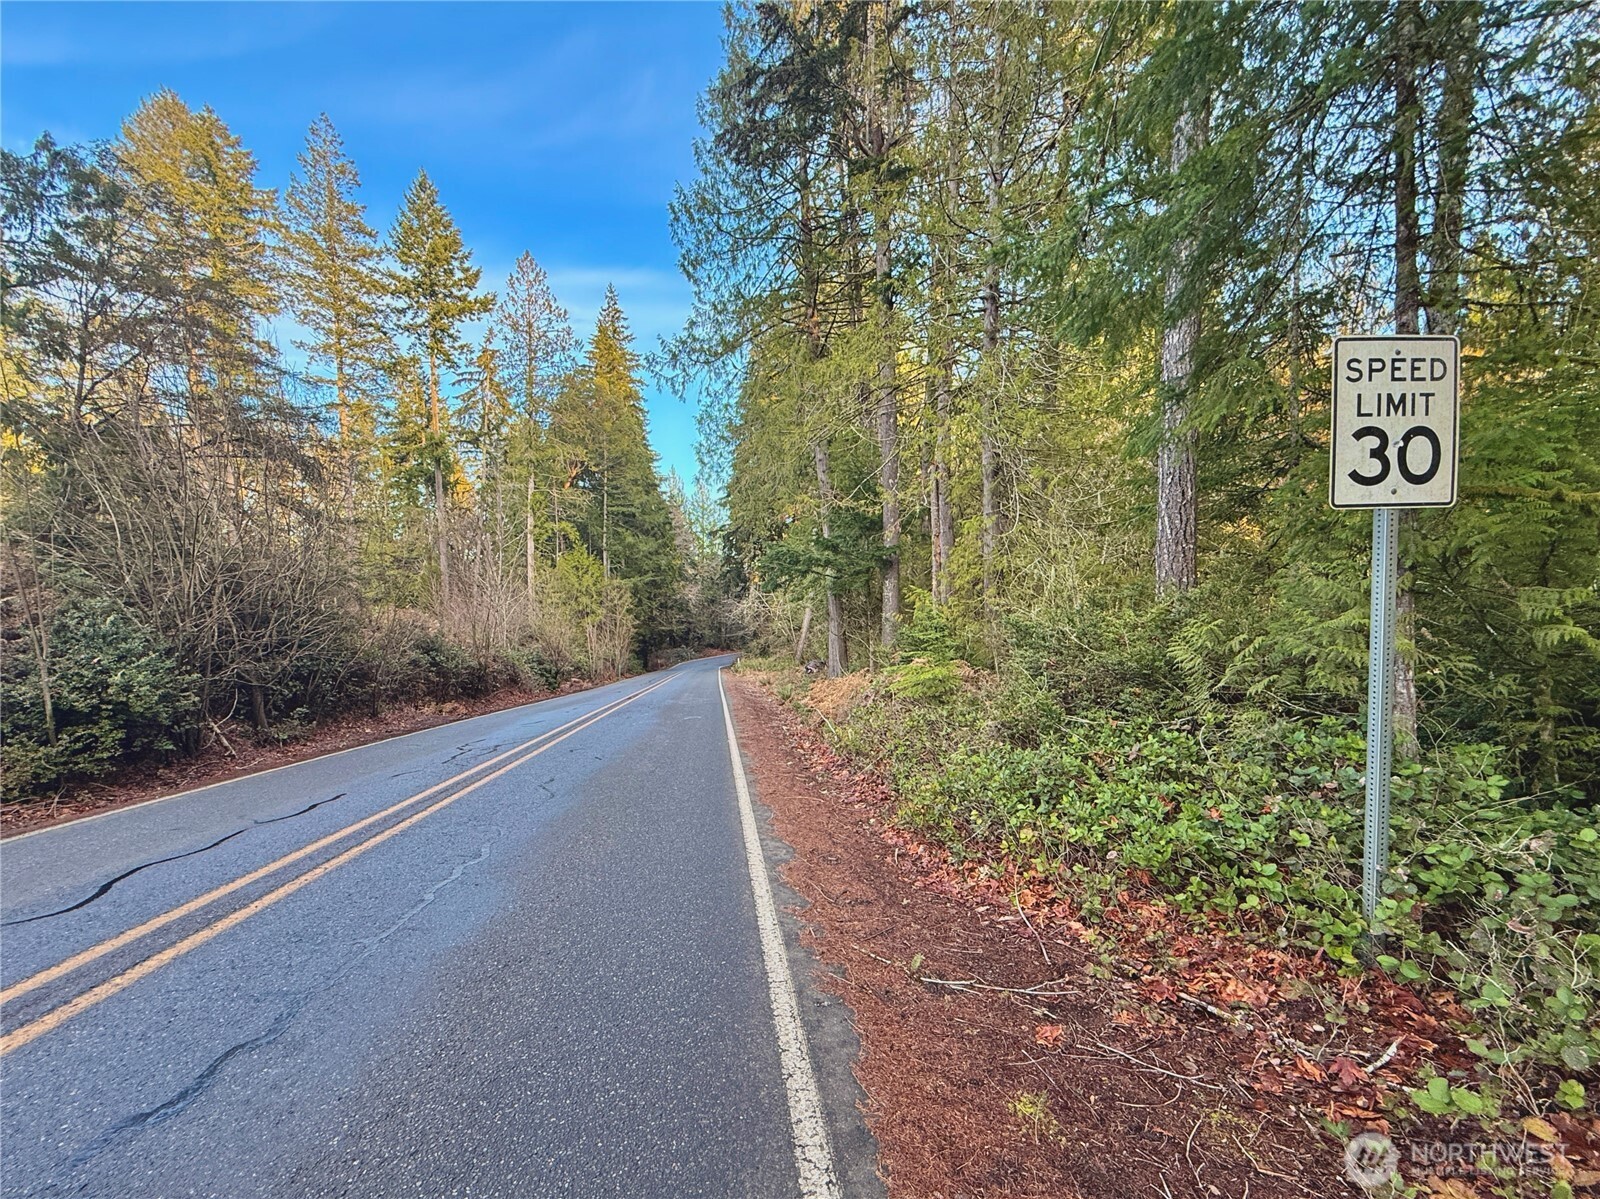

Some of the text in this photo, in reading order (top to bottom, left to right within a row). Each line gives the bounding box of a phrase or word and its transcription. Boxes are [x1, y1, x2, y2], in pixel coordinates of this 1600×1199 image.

[1345, 357, 1447, 383] SPEED
[1356, 392, 1436, 418] LIMIT
[1347, 425, 1442, 487] 30
